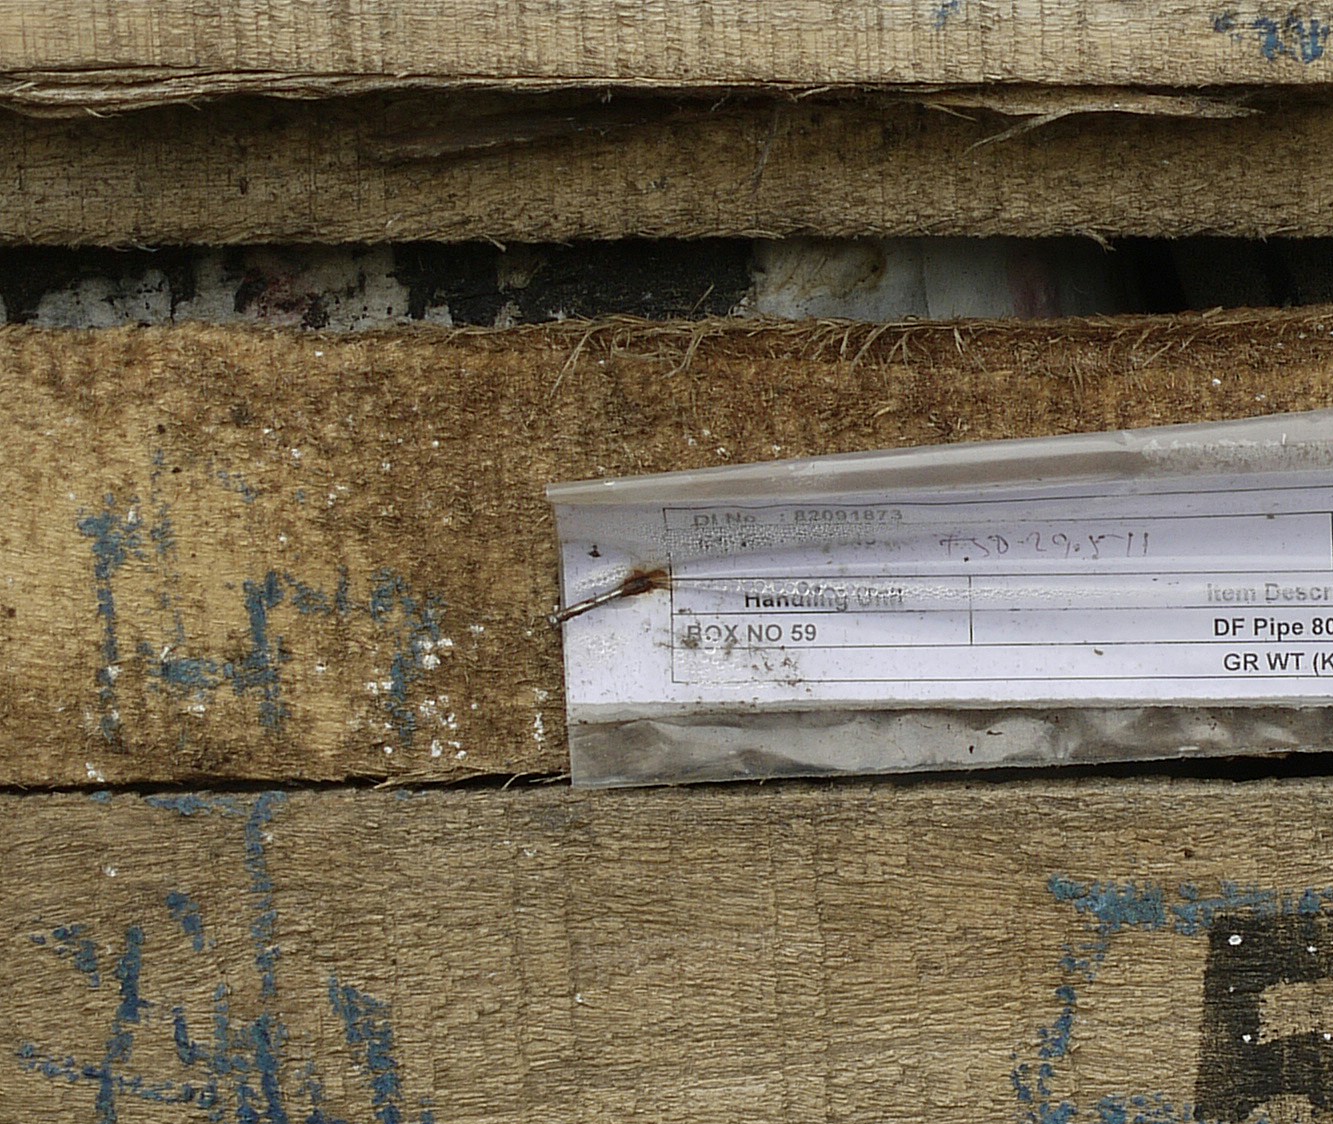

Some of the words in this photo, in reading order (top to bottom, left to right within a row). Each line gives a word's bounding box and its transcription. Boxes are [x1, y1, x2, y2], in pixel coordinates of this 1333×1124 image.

[686, 624, 739, 643] BOX
[746, 624, 783, 642] NO
[790, 623, 817, 642] 59
[1213, 618, 1246, 636] DF
[1253, 617, 1305, 642] Pipe
[1223, 653, 1260, 671] GR
[1266, 653, 1305, 670] WT
